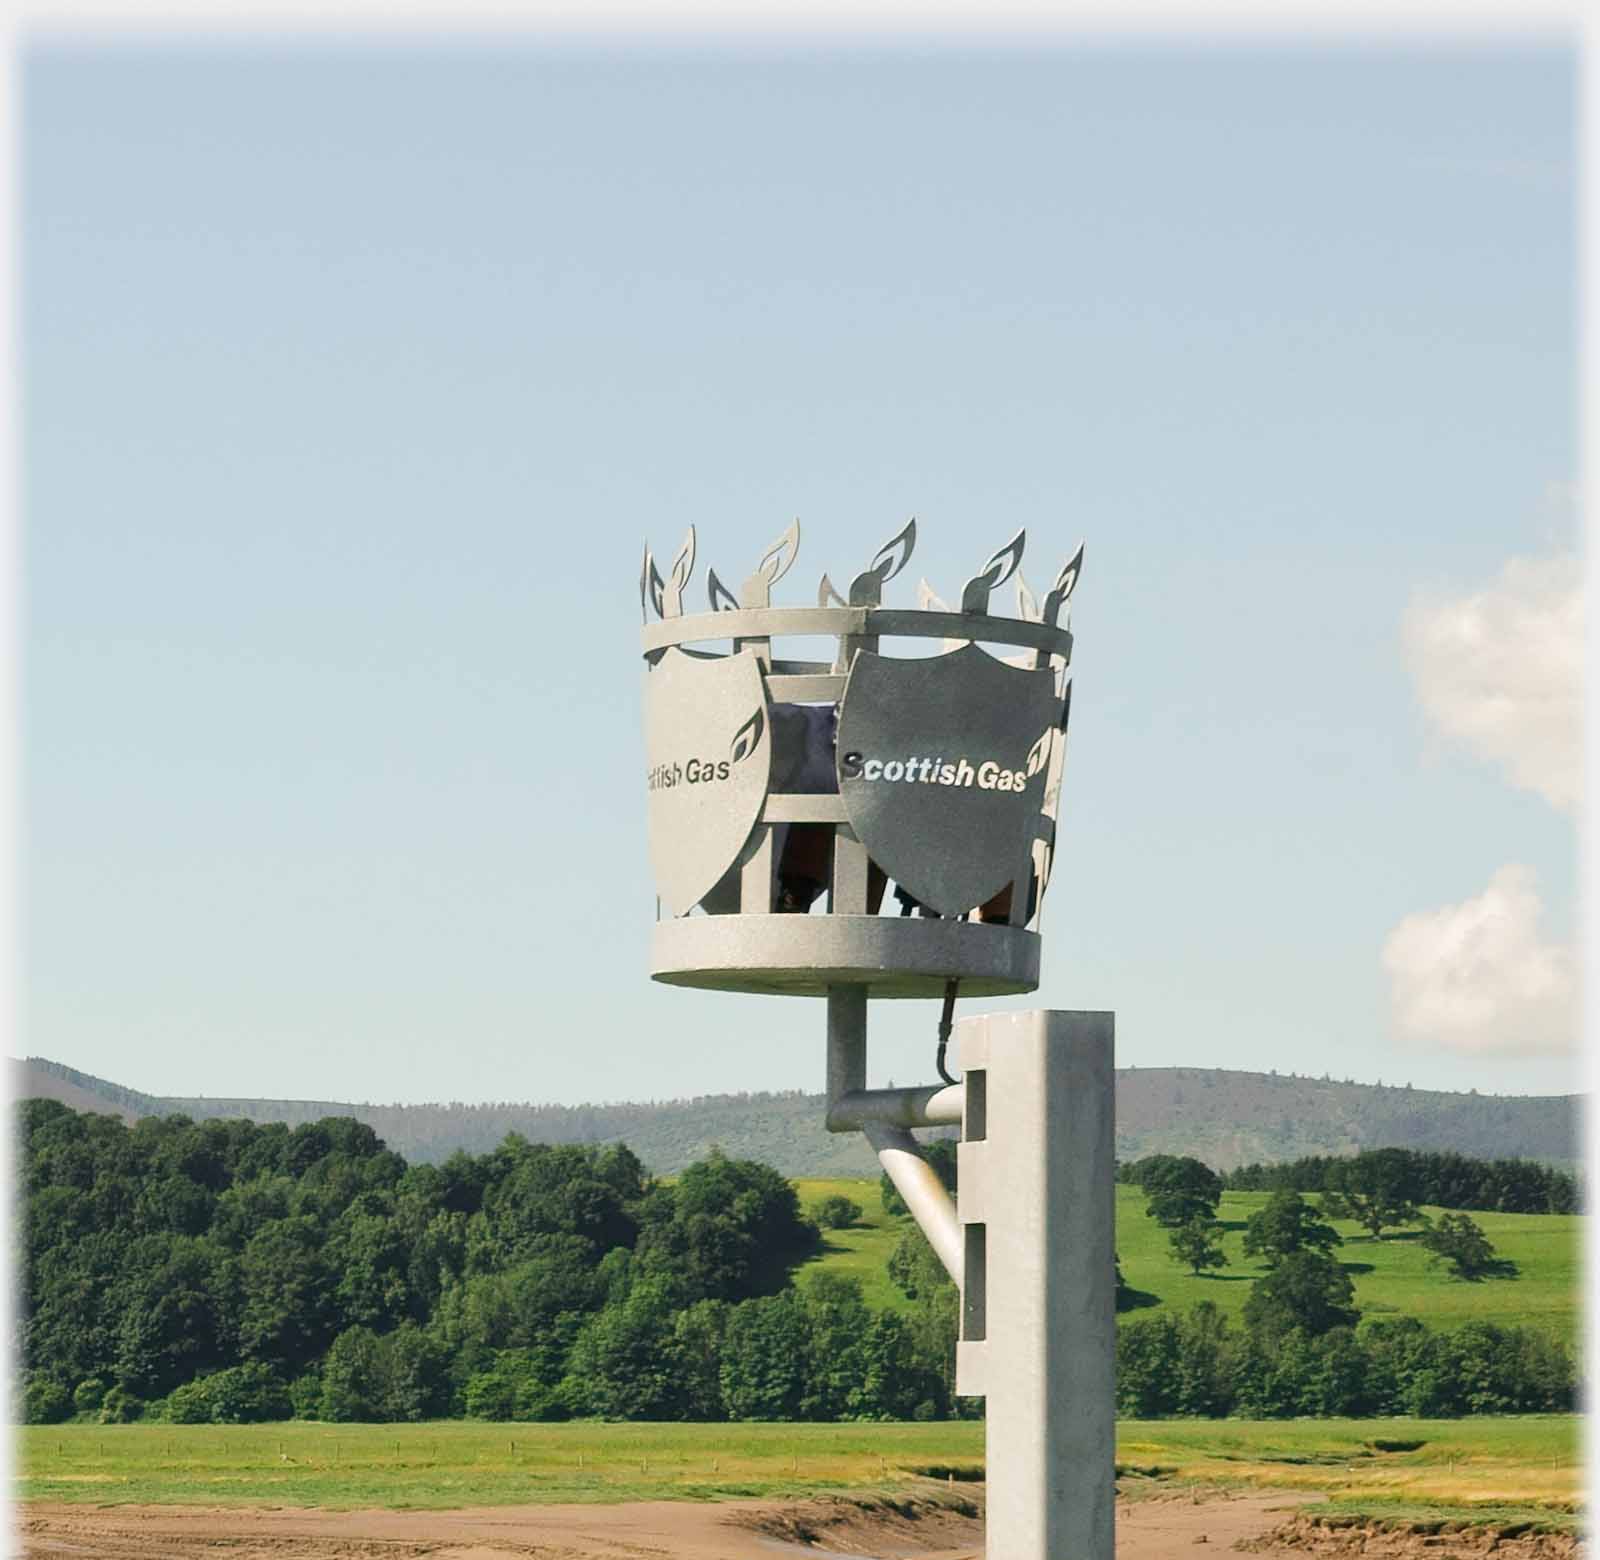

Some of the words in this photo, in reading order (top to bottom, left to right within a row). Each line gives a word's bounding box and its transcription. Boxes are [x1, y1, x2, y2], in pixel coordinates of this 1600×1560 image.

[648, 761, 682, 790] ttish
[686, 758, 730, 785] Gas
[843, 751, 975, 788] Scottish
[977, 761, 1027, 793] Gas
